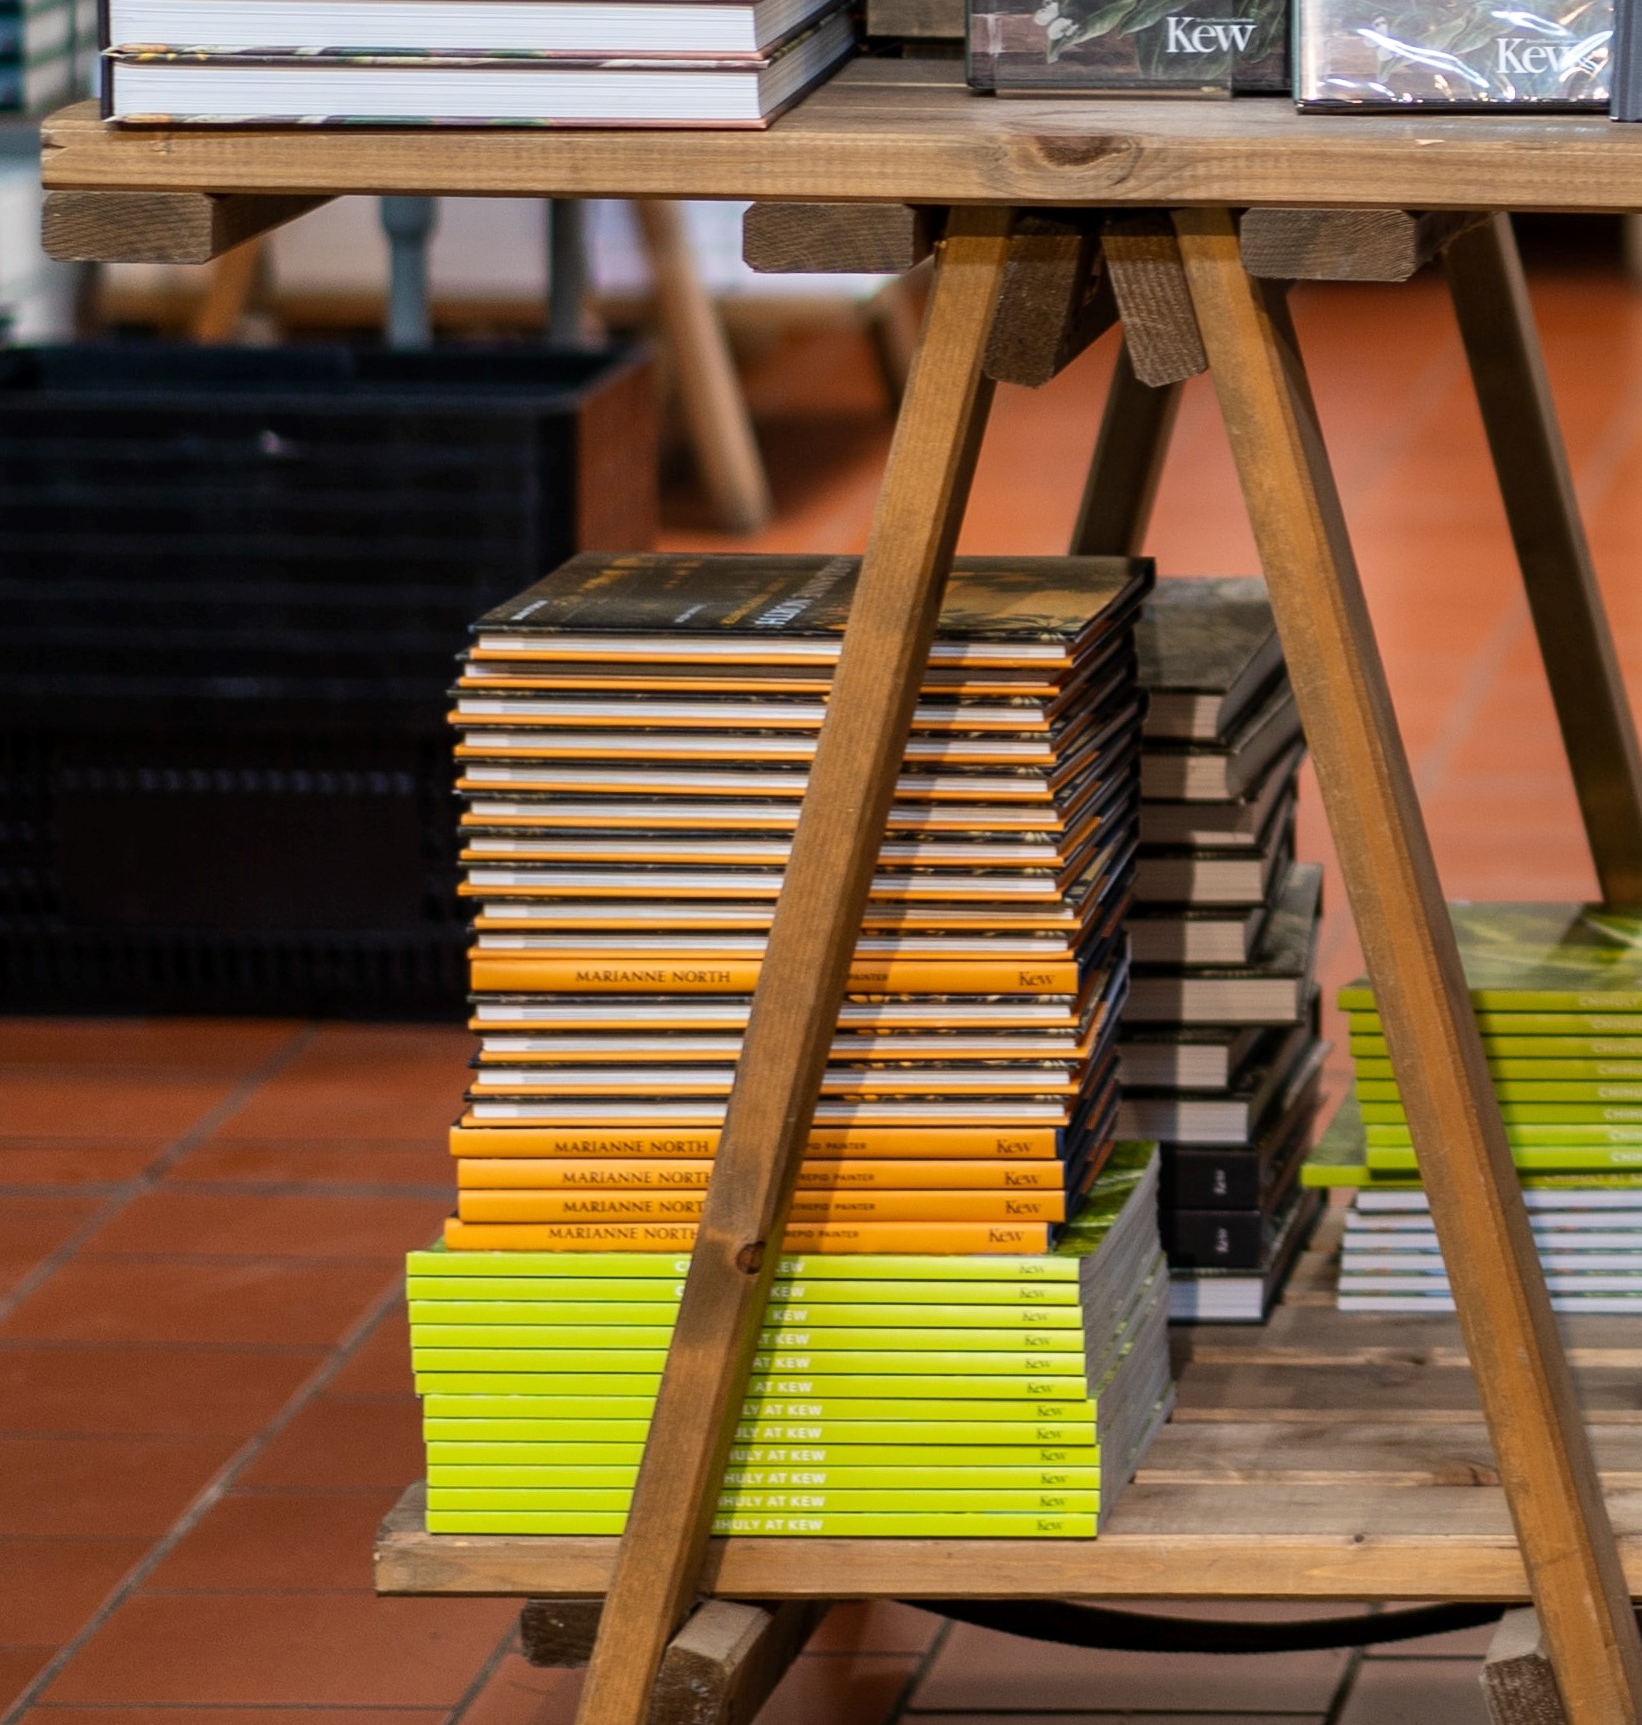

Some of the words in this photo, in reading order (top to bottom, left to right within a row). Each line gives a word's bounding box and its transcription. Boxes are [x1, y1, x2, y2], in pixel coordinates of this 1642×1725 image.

[1165, 16, 1256, 53] Kew
[575, 969, 666, 984] MARIANNE
[672, 969, 731, 984] NORTH
[1017, 970, 1056, 987] Kew
[554, 1140, 646, 1154] MARIANNE
[650, 1140, 709, 1154] NORTH
[995, 1138, 1034, 1154] Kew
[765, 1405, 784, 1416] AT
[787, 1404, 822, 1416] KEW
